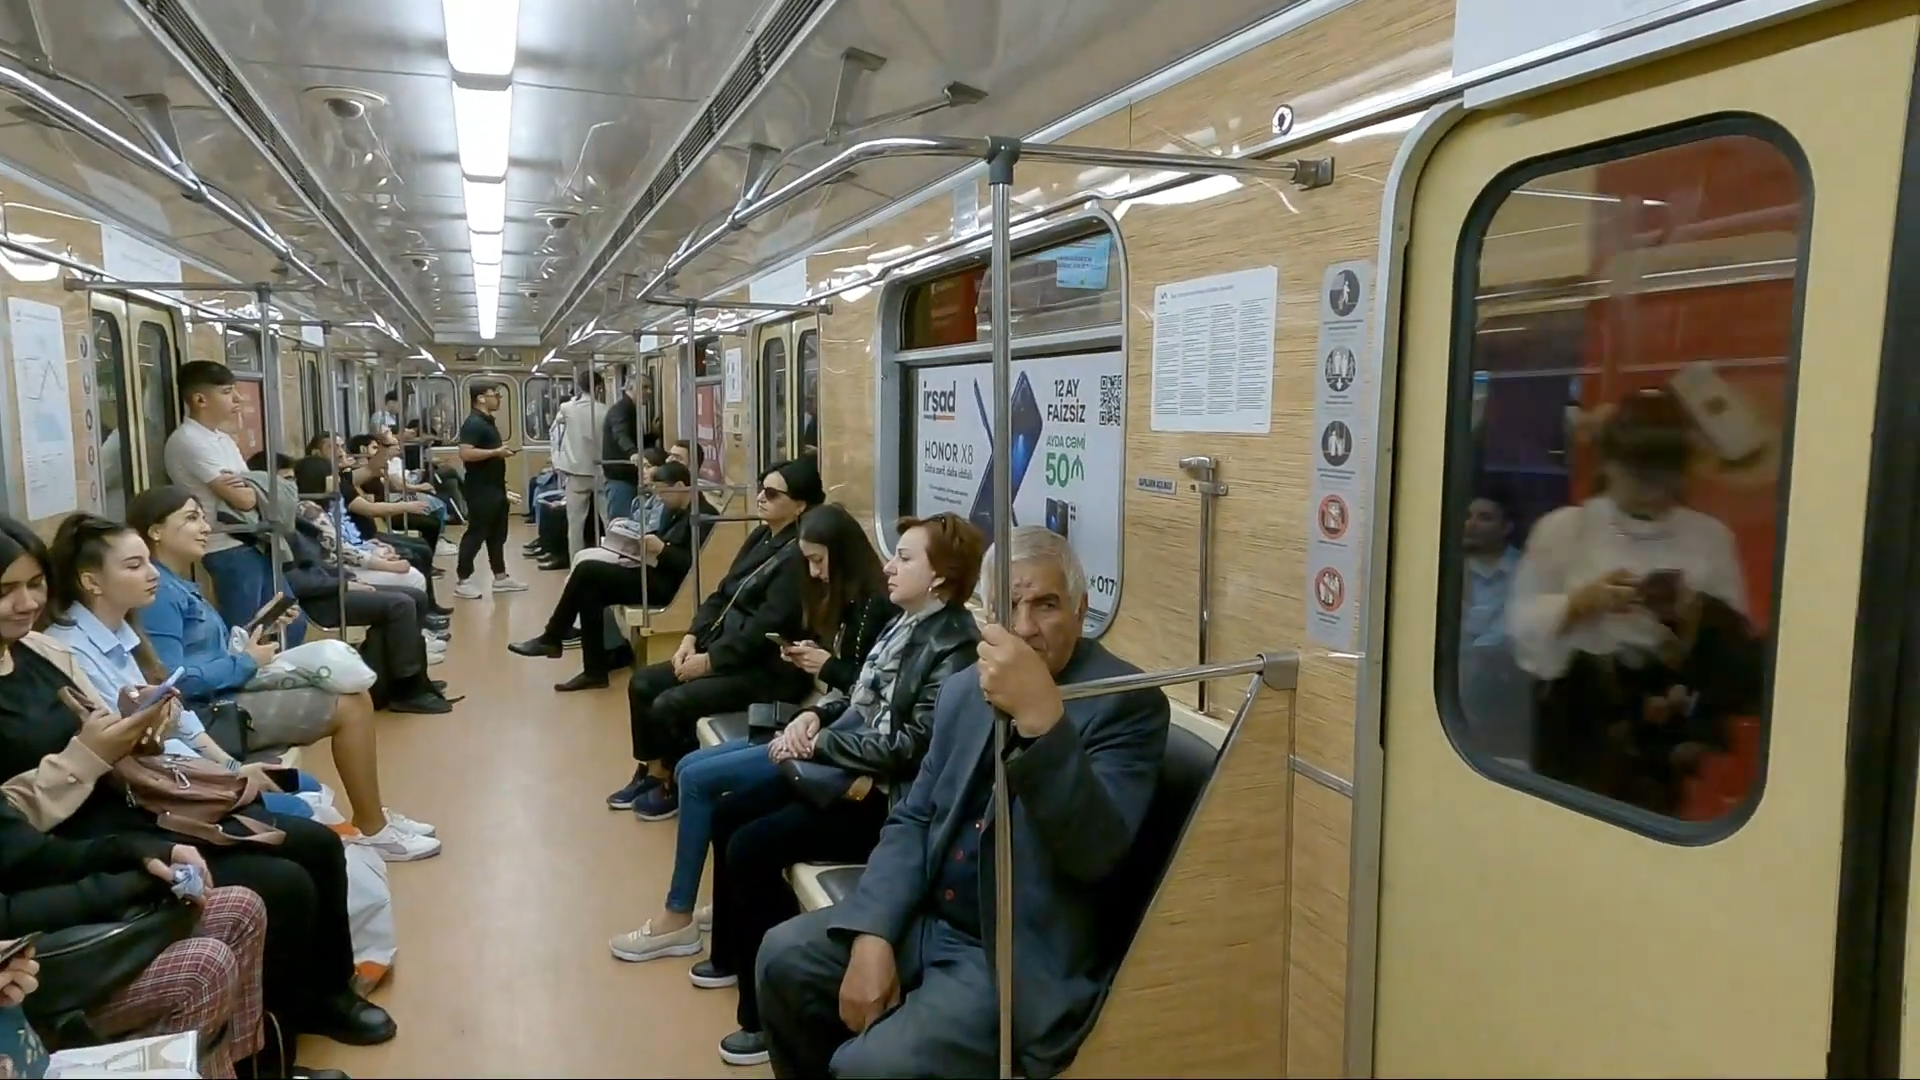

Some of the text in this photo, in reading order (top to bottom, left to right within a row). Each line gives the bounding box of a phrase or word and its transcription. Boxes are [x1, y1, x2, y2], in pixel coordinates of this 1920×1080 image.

[1054, 379, 1080, 398] 12 AY
[1046, 434, 1065, 448] AYDA
[925, 440, 974, 465] HONOR X8
